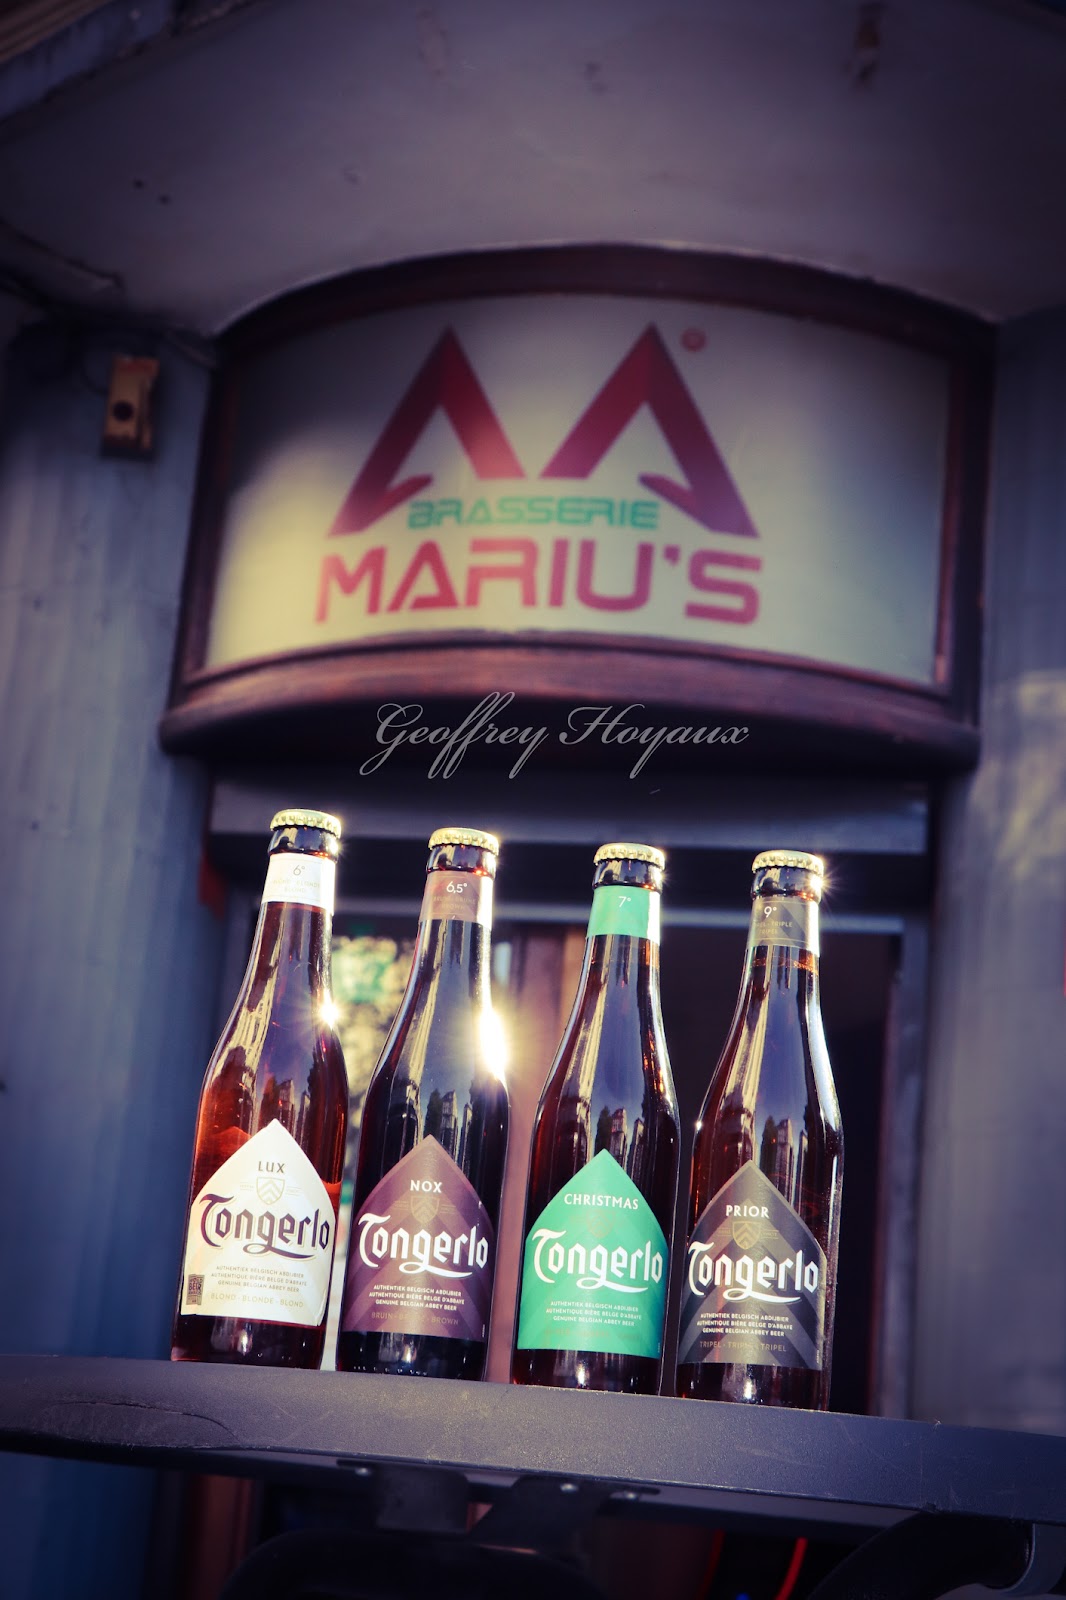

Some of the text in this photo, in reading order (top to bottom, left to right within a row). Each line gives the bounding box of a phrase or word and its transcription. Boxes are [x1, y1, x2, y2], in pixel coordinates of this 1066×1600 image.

[407, 496, 660, 530] BRASSERIE
[315, 536, 763, 625] MARIU'S
[258, 1160, 285, 1174] LUX
[410, 1179, 443, 1194] NOX
[564, 1193, 639, 1210] CHRISTMAS
[725, 1204, 770, 1219] PRIOR
[199, 1193, 331, 1259] Tongerlo
[358, 1212, 489, 1278] Tongerlo
[531, 1228, 663, 1293] Tongerlo
[687, 1241, 819, 1303] Tongerlo
[210, 1292, 236, 1300] BLOND
[242, 1295, 274, 1304] BLONDE
[280, 1298, 304, 1308] BLOND
[699, 1340, 787, 1352] TRIPEL TRIP TRIPEL
